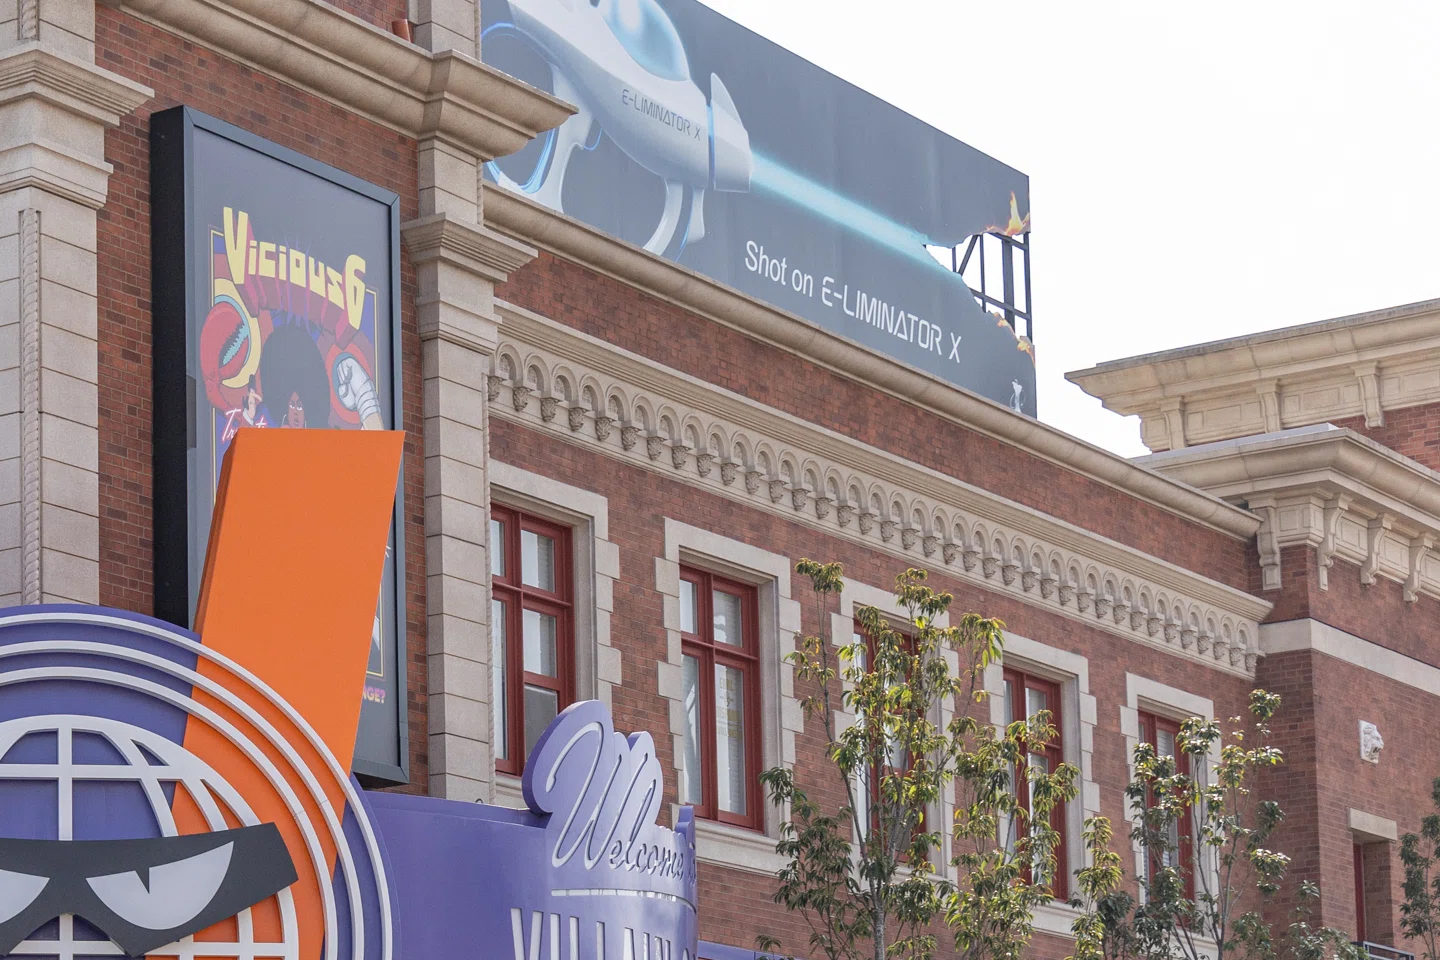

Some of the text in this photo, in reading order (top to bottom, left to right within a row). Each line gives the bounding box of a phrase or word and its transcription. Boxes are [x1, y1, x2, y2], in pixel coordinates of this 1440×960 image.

[621, 88, 702, 142] E-LIMINATOR X
[744, 240, 963, 364] Shot on E-LIMINATOR X
[545, 720, 685, 881] Welcome
